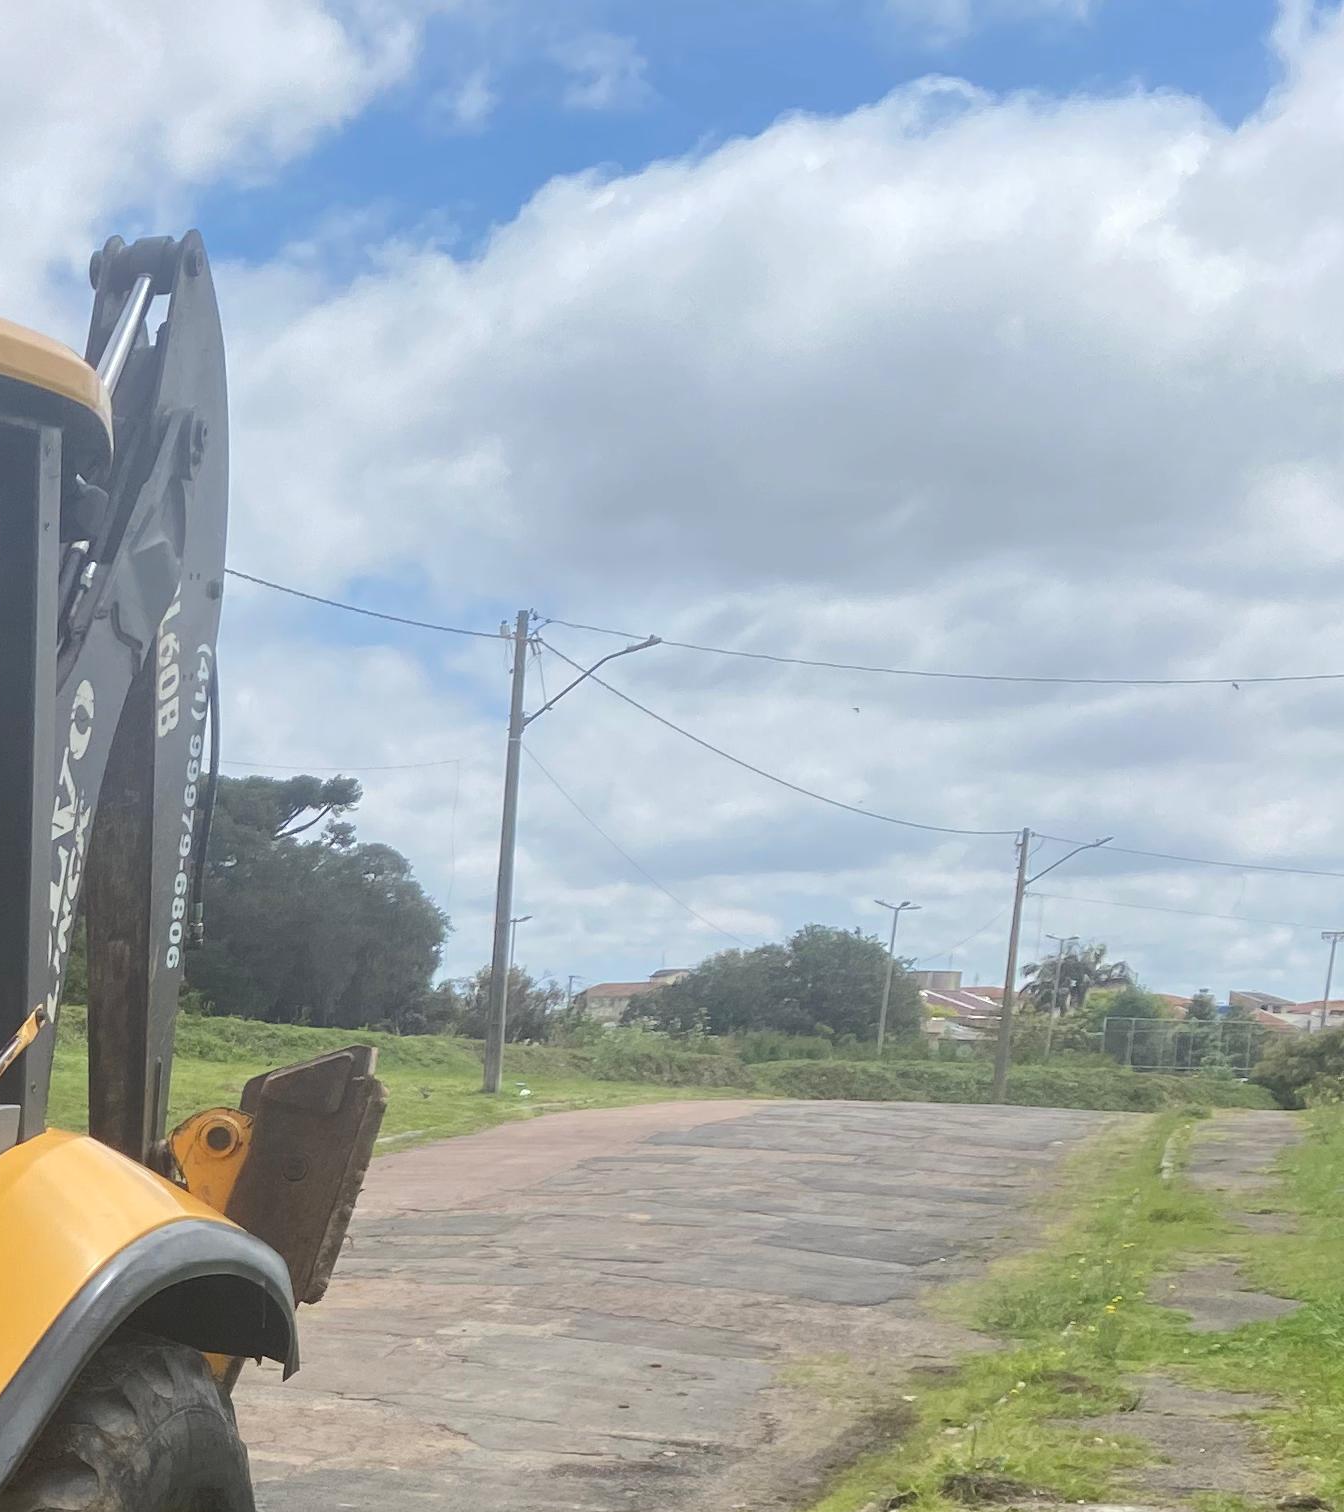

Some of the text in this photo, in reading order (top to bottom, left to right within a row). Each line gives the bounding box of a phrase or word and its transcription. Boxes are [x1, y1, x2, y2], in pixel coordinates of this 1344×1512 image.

[158, 581, 182, 737] L60B
[166, 643, 212, 968] (41) 99979-6806
